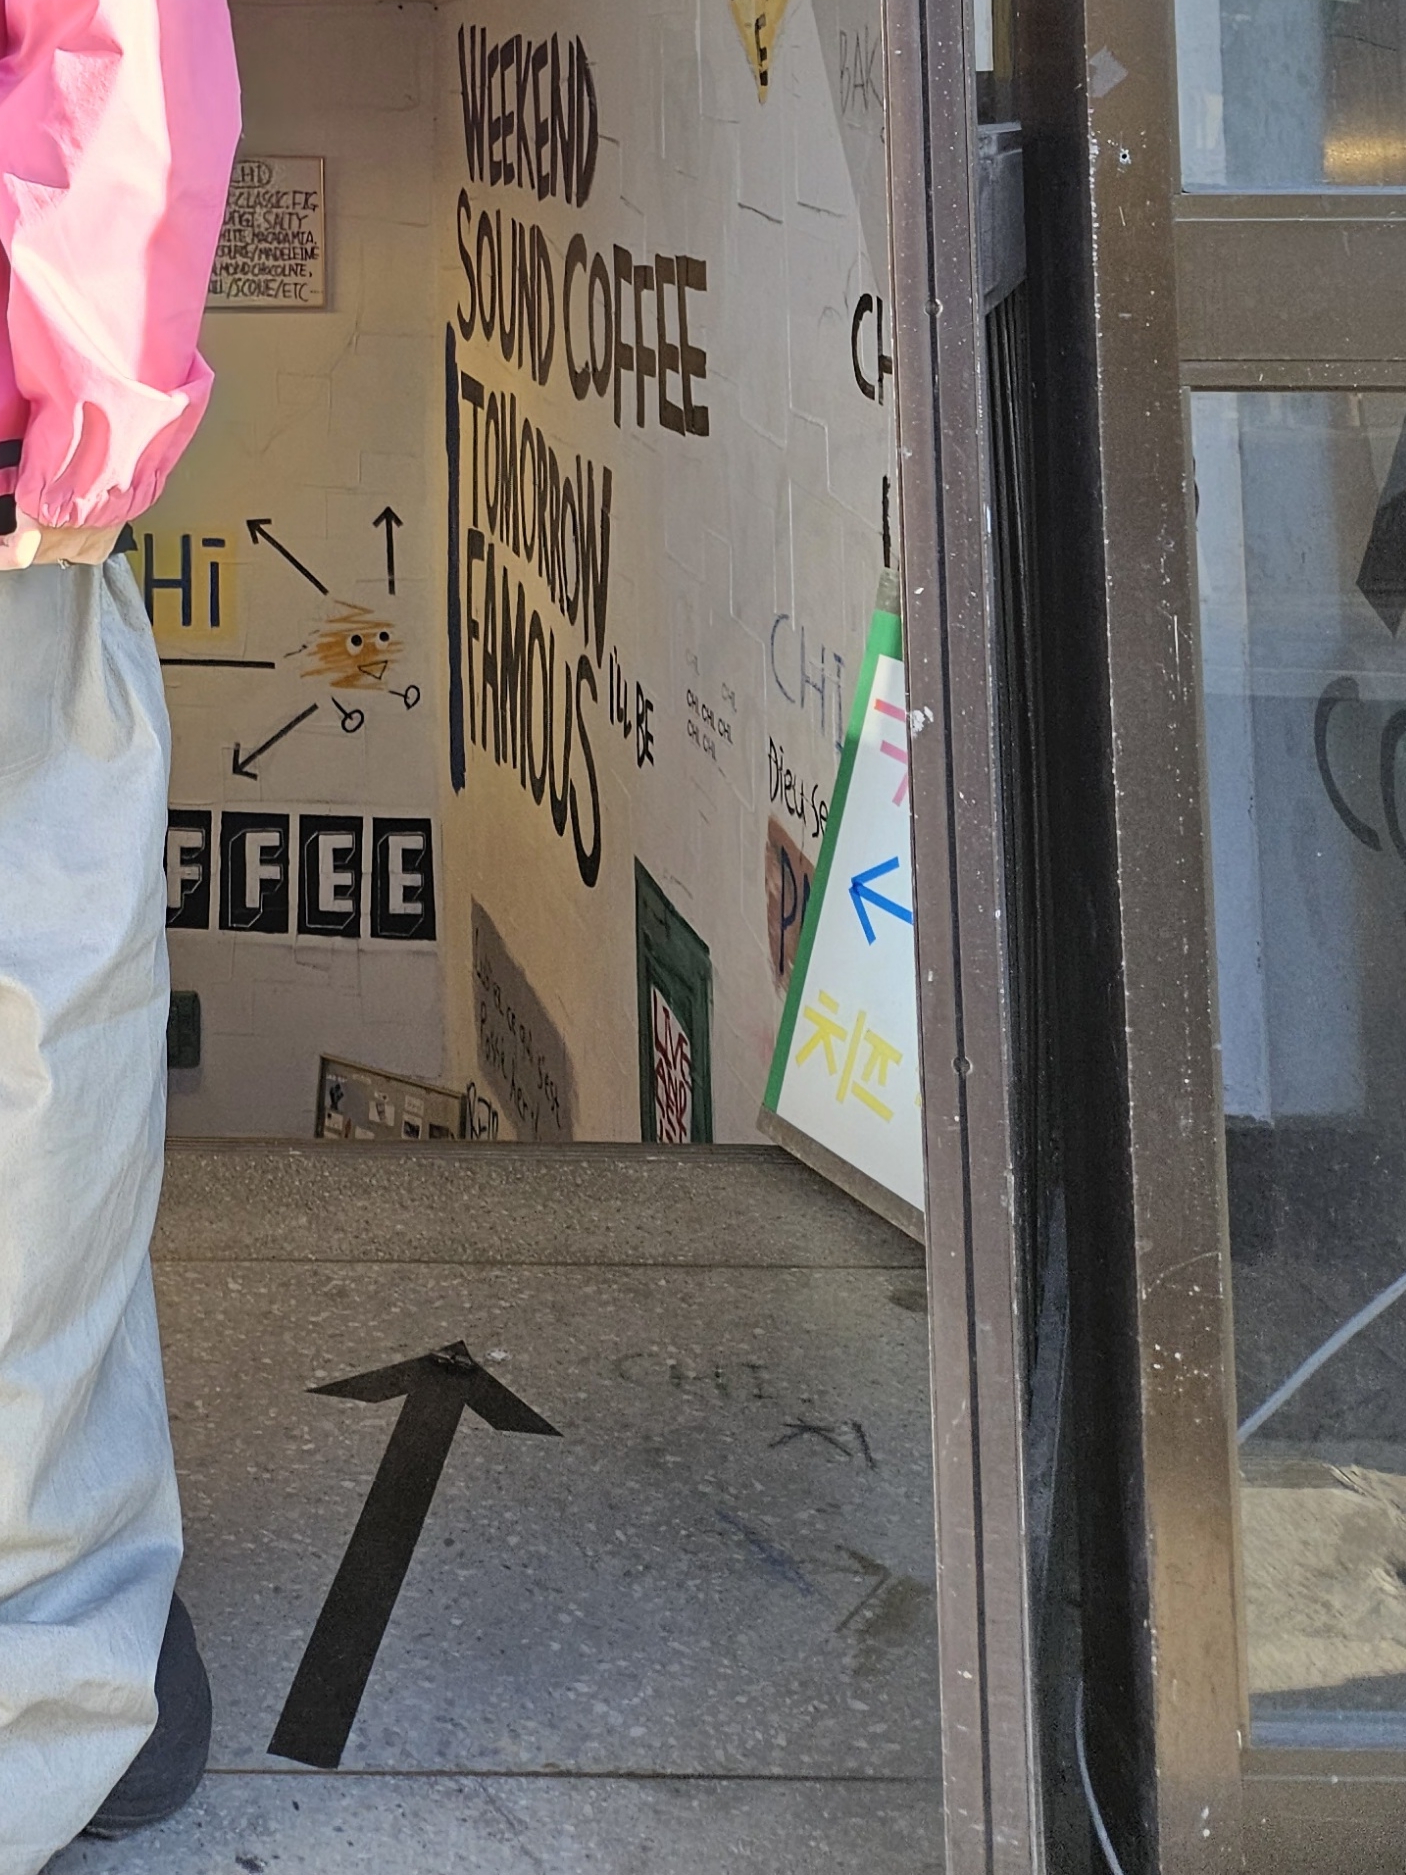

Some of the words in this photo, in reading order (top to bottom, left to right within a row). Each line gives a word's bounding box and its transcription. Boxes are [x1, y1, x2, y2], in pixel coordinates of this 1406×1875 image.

[457, 23, 598, 208] WEEKEND
[456, 186, 555, 387] SOUND
[563, 233, 710, 437] COFFEE
[461, 369, 613, 668] TOMORROW
[466, 527, 602, 888] FAMOUS
[636, 681, 655, 768] BE
